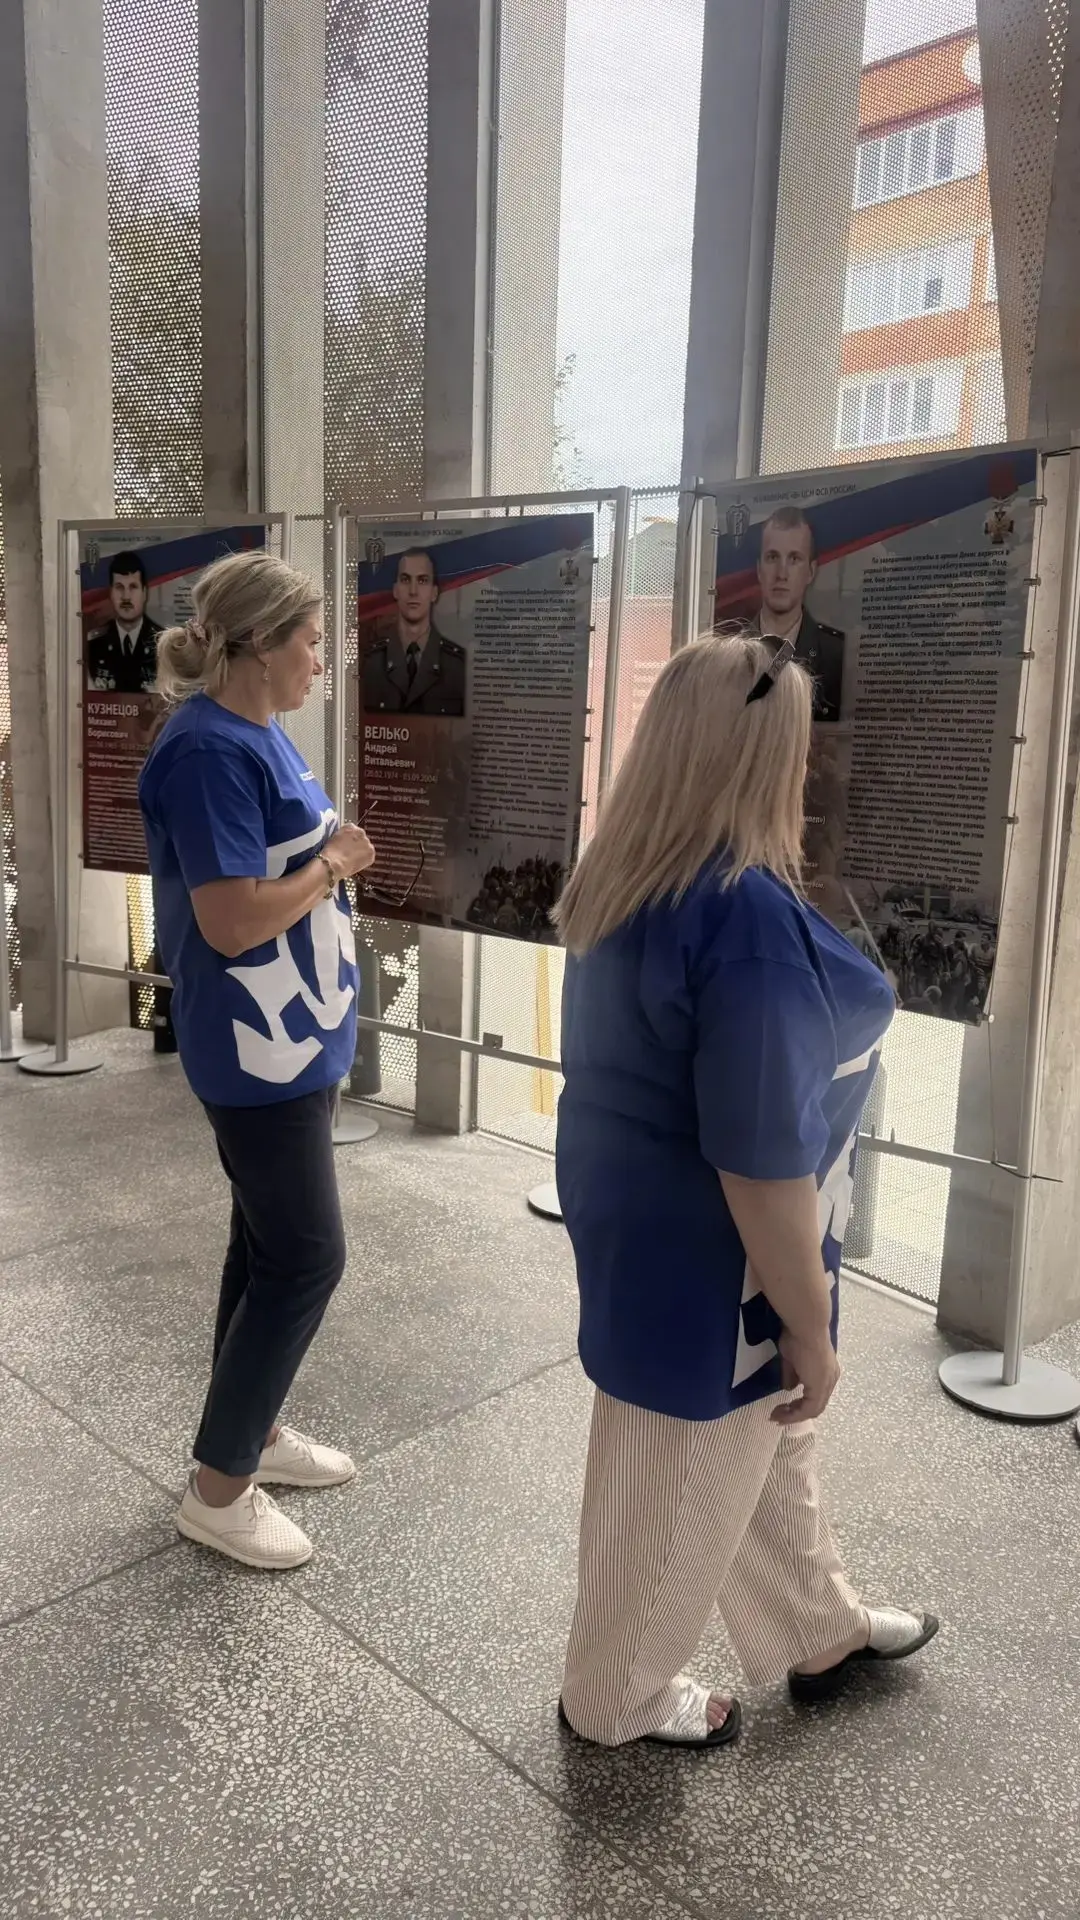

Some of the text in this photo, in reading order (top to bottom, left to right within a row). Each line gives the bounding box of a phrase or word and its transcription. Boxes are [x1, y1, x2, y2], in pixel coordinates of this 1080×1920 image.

[829, 484, 857, 494] РОССИИ
[87, 703, 139, 717] КУЗНЕЦОВ
[88, 728, 129, 739] Борисович
[365, 726, 410, 741] ВЕЛЬКО
[364, 742, 398, 755] Андрей
[365, 755, 416, 769] Витальевич
